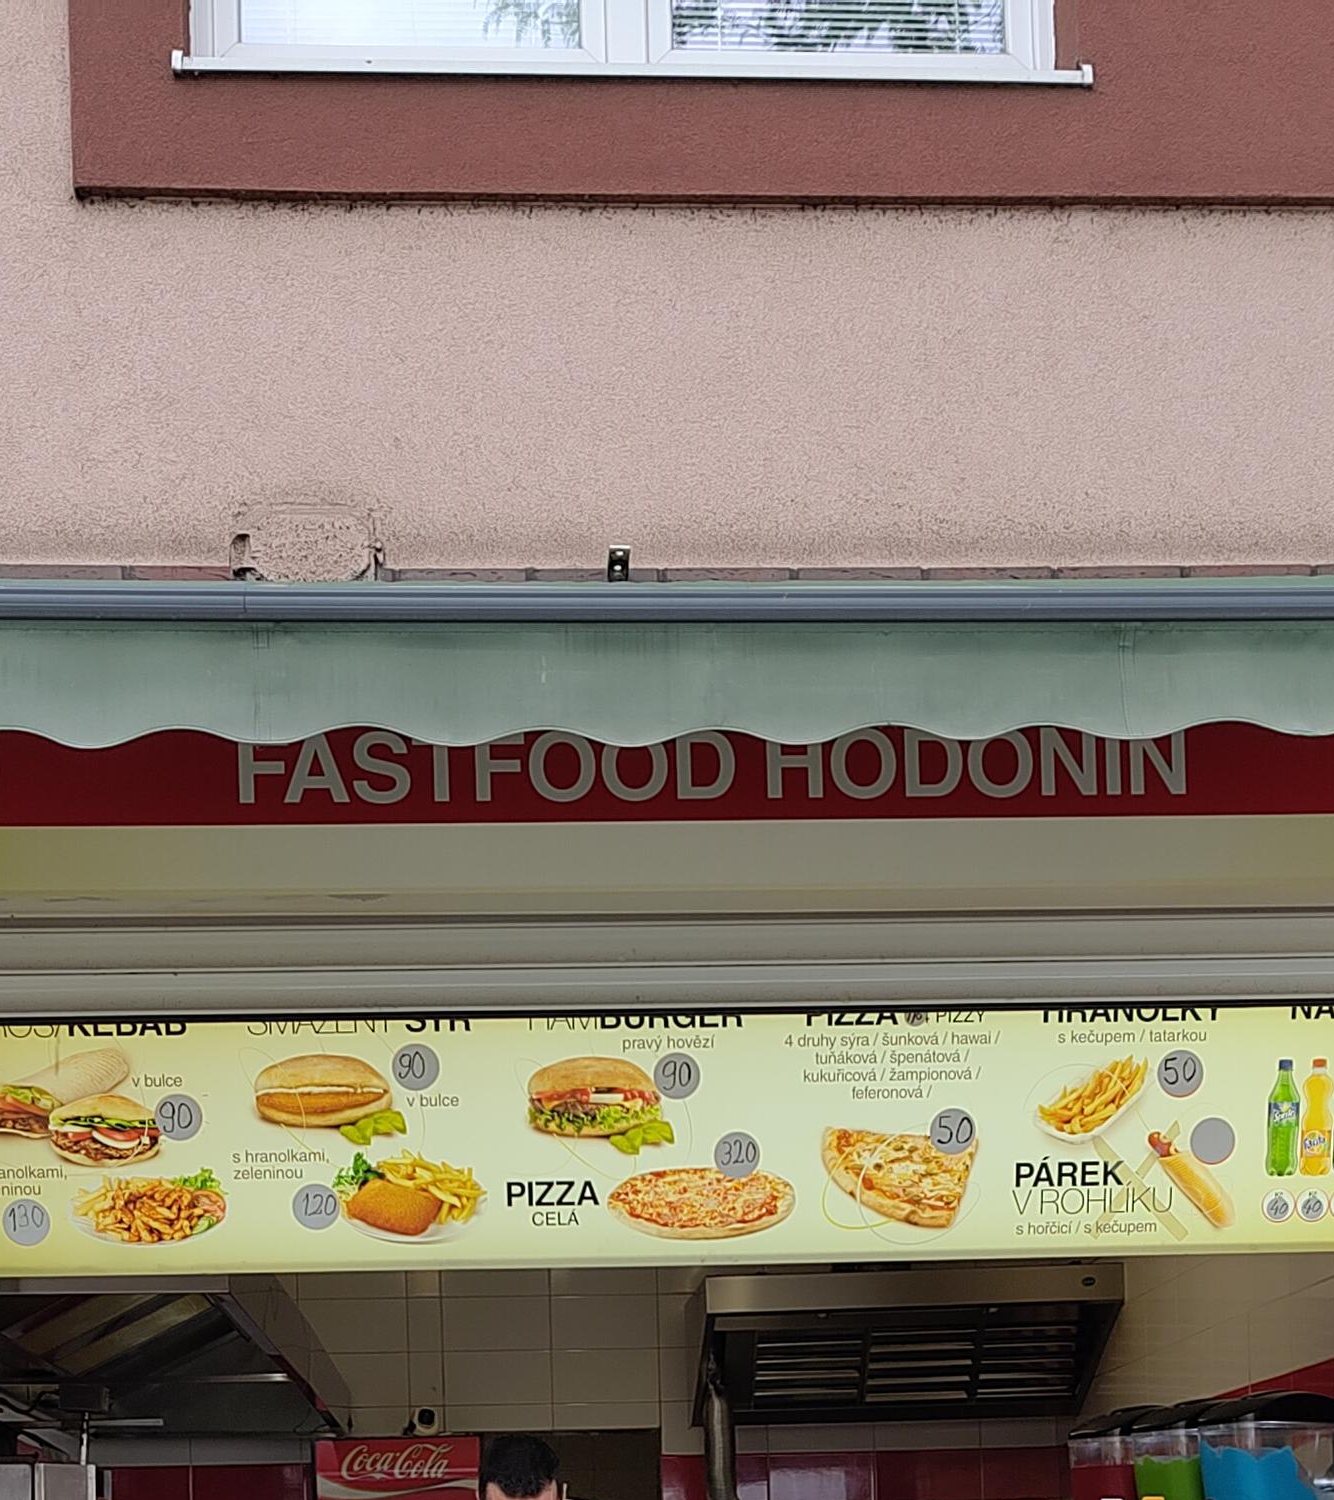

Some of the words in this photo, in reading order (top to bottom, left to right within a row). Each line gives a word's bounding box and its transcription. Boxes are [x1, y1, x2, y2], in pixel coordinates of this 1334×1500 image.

[237, 732, 737, 803] FASTFOOD
[769, 726, 1187, 800] HODONIN
[936, 1011, 985, 1024] PIZZY
[622, 1035, 662, 1053] pravý
[784, 1035, 793, 1047] 4
[798, 1034, 836, 1050] druhy
[840, 1032, 869, 1050] sýra
[882, 1031, 939, 1046] šunková
[1058, 1031, 1066, 1043] s
[1071, 1029, 1135, 1045] kečupem
[1149, 1029, 1207, 1043] tatarkou
[398, 1051, 426, 1079] 90
[815, 1049, 877, 1065] tuňáková
[890, 1049, 960, 1066] špenátová
[662, 1060, 692, 1091] 90
[803, 1068, 876, 1083] kukuřicová
[889, 1066, 972, 1083] žampionová
[1163, 1056, 1198, 1085] 50
[132, 1076, 142, 1087] v
[144, 1074, 182, 1088] bulce
[407, 1096, 416, 1107] v
[419, 1094, 459, 1108] bulce
[852, 1085, 923, 1100] feferonová
[159, 1101, 192, 1133] 90
[936, 1115, 973, 1144] 50
[232, 1153, 241, 1163] s
[244, 1149, 330, 1165] hranolkami,
[720, 1139, 757, 1166] 320
[233, 1166, 303, 1180] zeleninou
[1015, 1157, 1124, 1187] PÁREK
[506, 1180, 600, 1207] PIZZA
[1011, 1190, 1034, 1215] V
[1039, 1182, 1173, 1215] ROHLÍKU
[302, 1193, 337, 1217] 120
[8, 1208, 45, 1232] 130
[531, 1208, 579, 1227] CELÁ
[1016, 1224, 1024, 1234] s
[1027, 1221, 1071, 1235] hořčicí
[1084, 1224, 1092, 1234] s
[1096, 1220, 1157, 1237] kečupem
